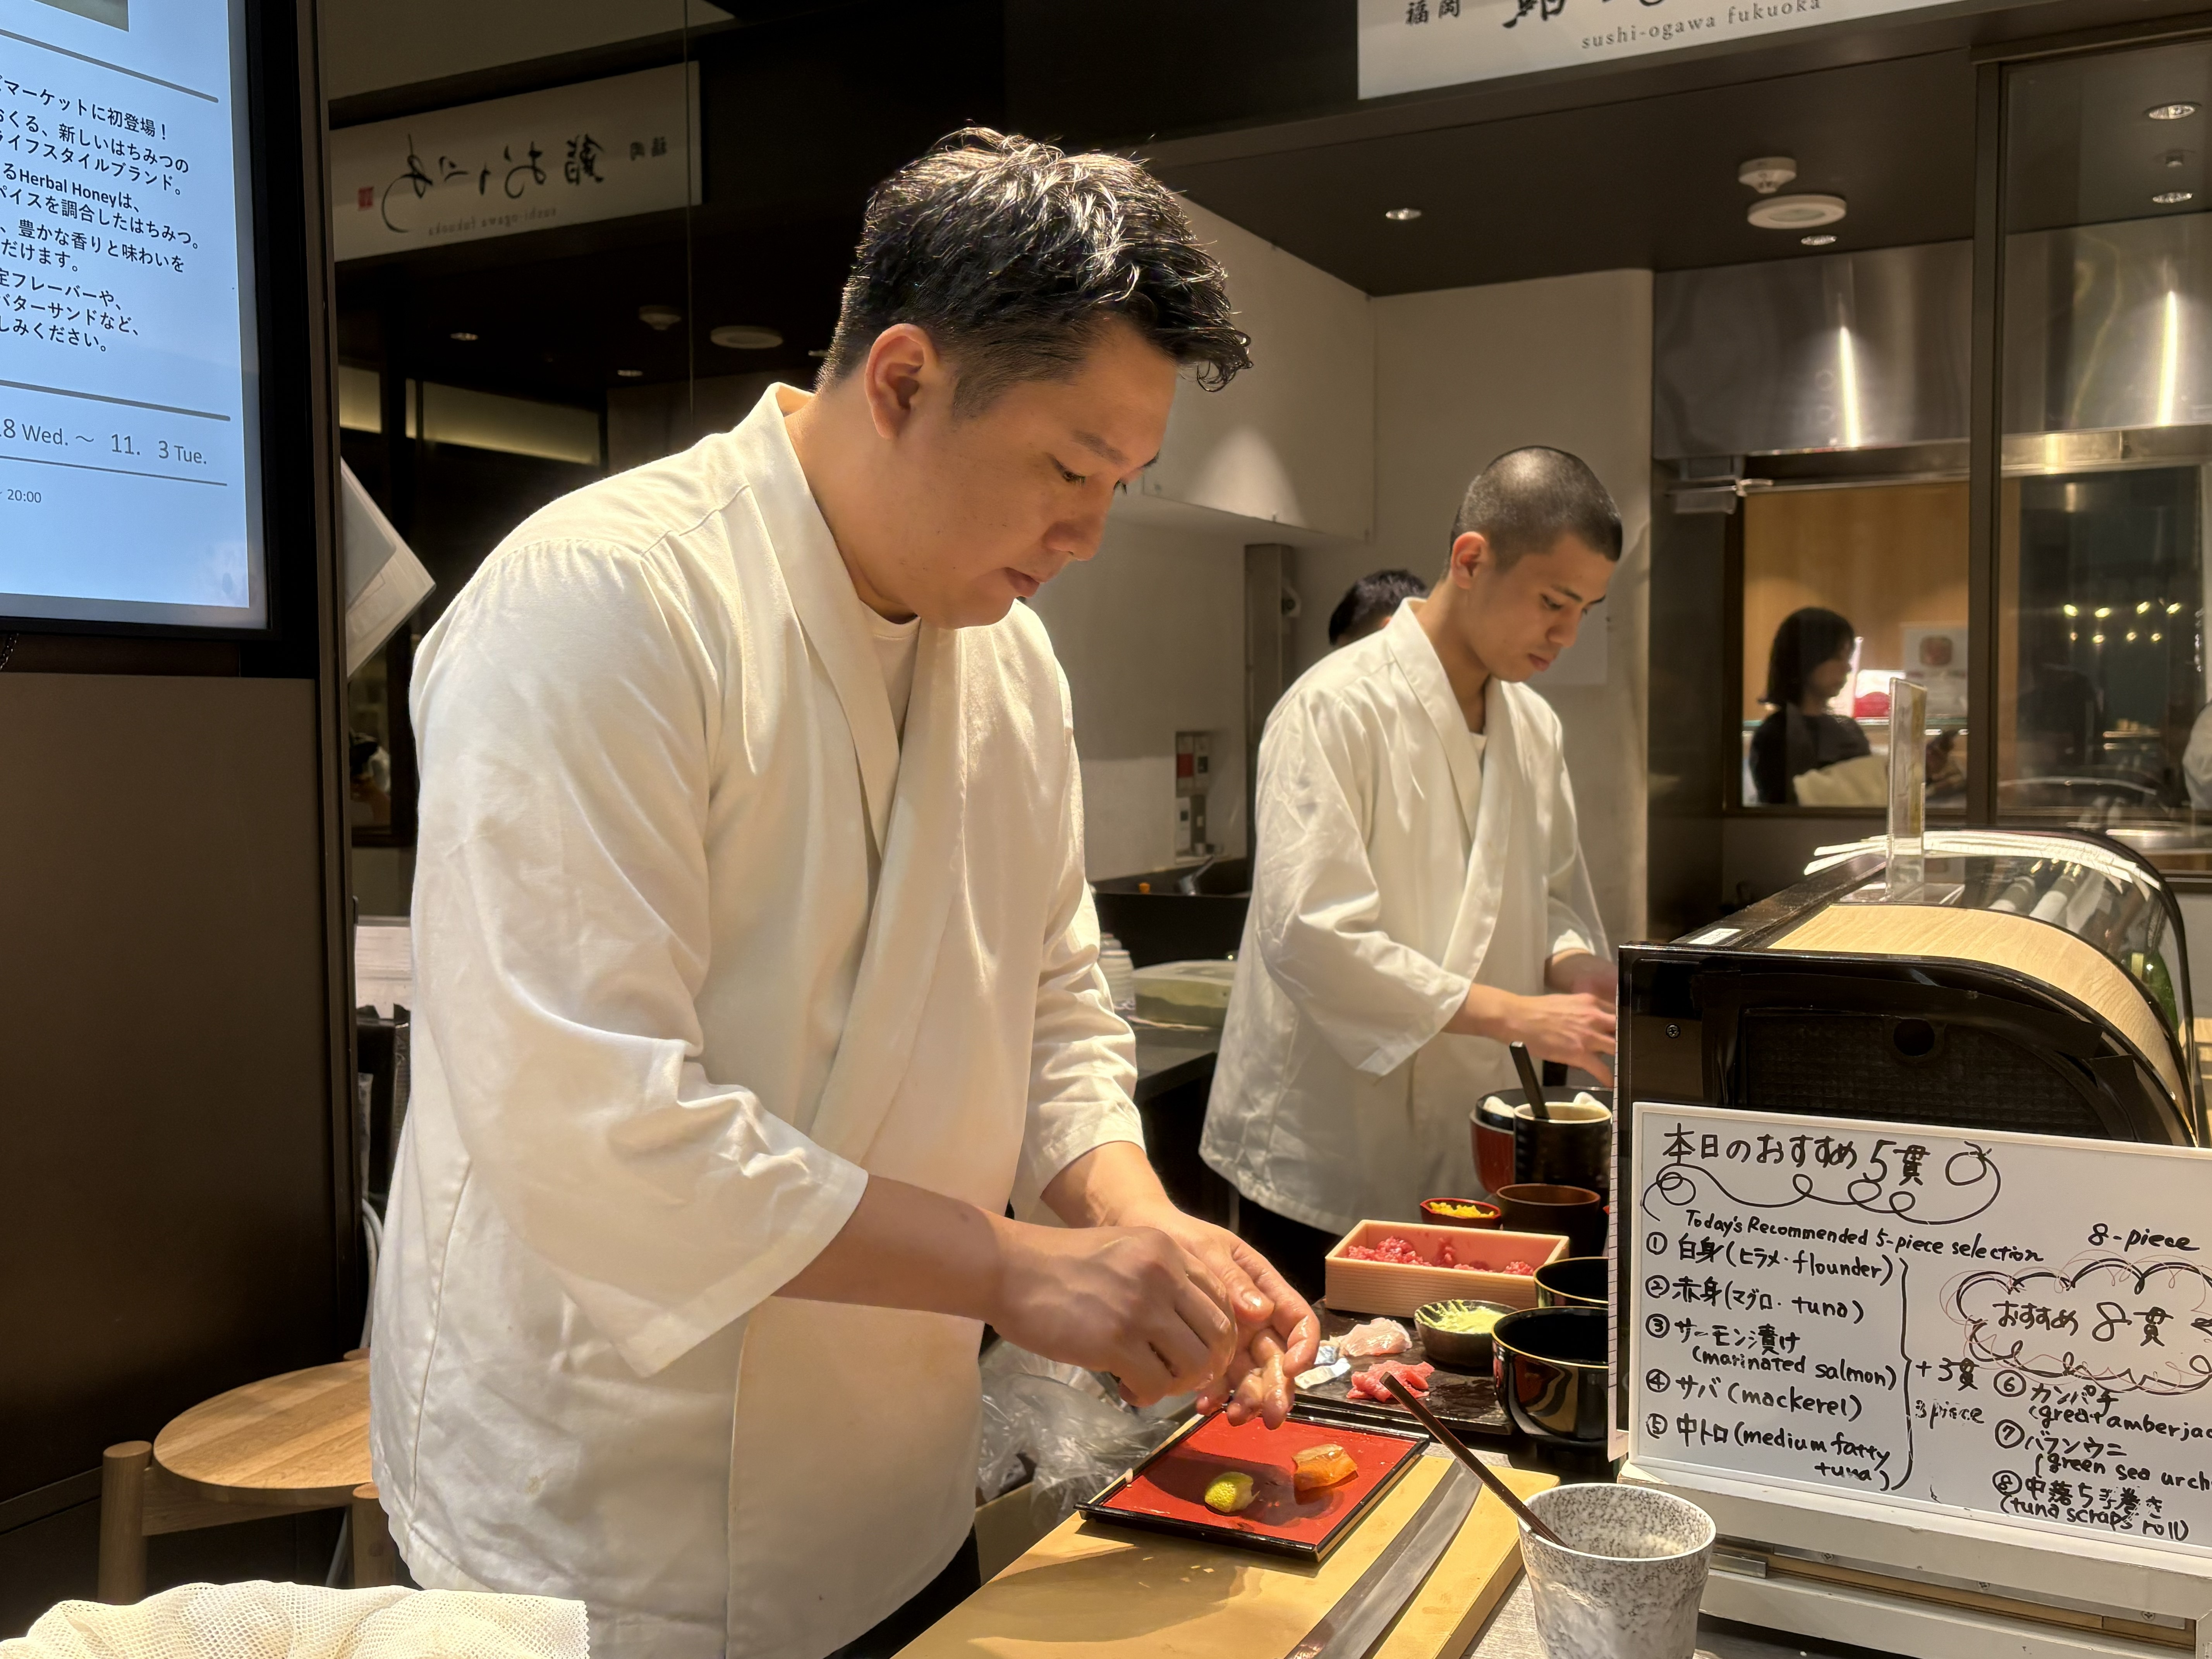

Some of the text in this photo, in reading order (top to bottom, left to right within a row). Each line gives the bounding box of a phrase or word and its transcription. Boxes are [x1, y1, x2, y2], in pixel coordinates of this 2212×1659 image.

[1581, 0, 1822, 49] sushi-ogawa fukuoka
[0, 75, 166, 140] マーケットに初登場！
[0, 130, 180, 195] イフスタイルブランド。
[1, 239, 78, 272] だけます。
[0, 419, 15, 438] 8
[22, 424, 68, 446] Wed.
[112, 434, 141, 455] 11.
[158, 440, 169, 459] 3
[174, 445, 207, 464] Tue.
[7, 489, 41, 503] 20:00
[1686, 1209, 2044, 1262] Today's Recommended 5-piece selection
[2088, 1223, 2200, 1252] 8-piece
[1674, 1317, 1801, 1355] サーモン漬け
[1692, 1345, 1897, 1391] (marinated salmon)
[1831, 1431, 1890, 1471] fatty
[2115, 1464, 2150, 1480] sea
[2160, 1470, 2212, 1491] urch
